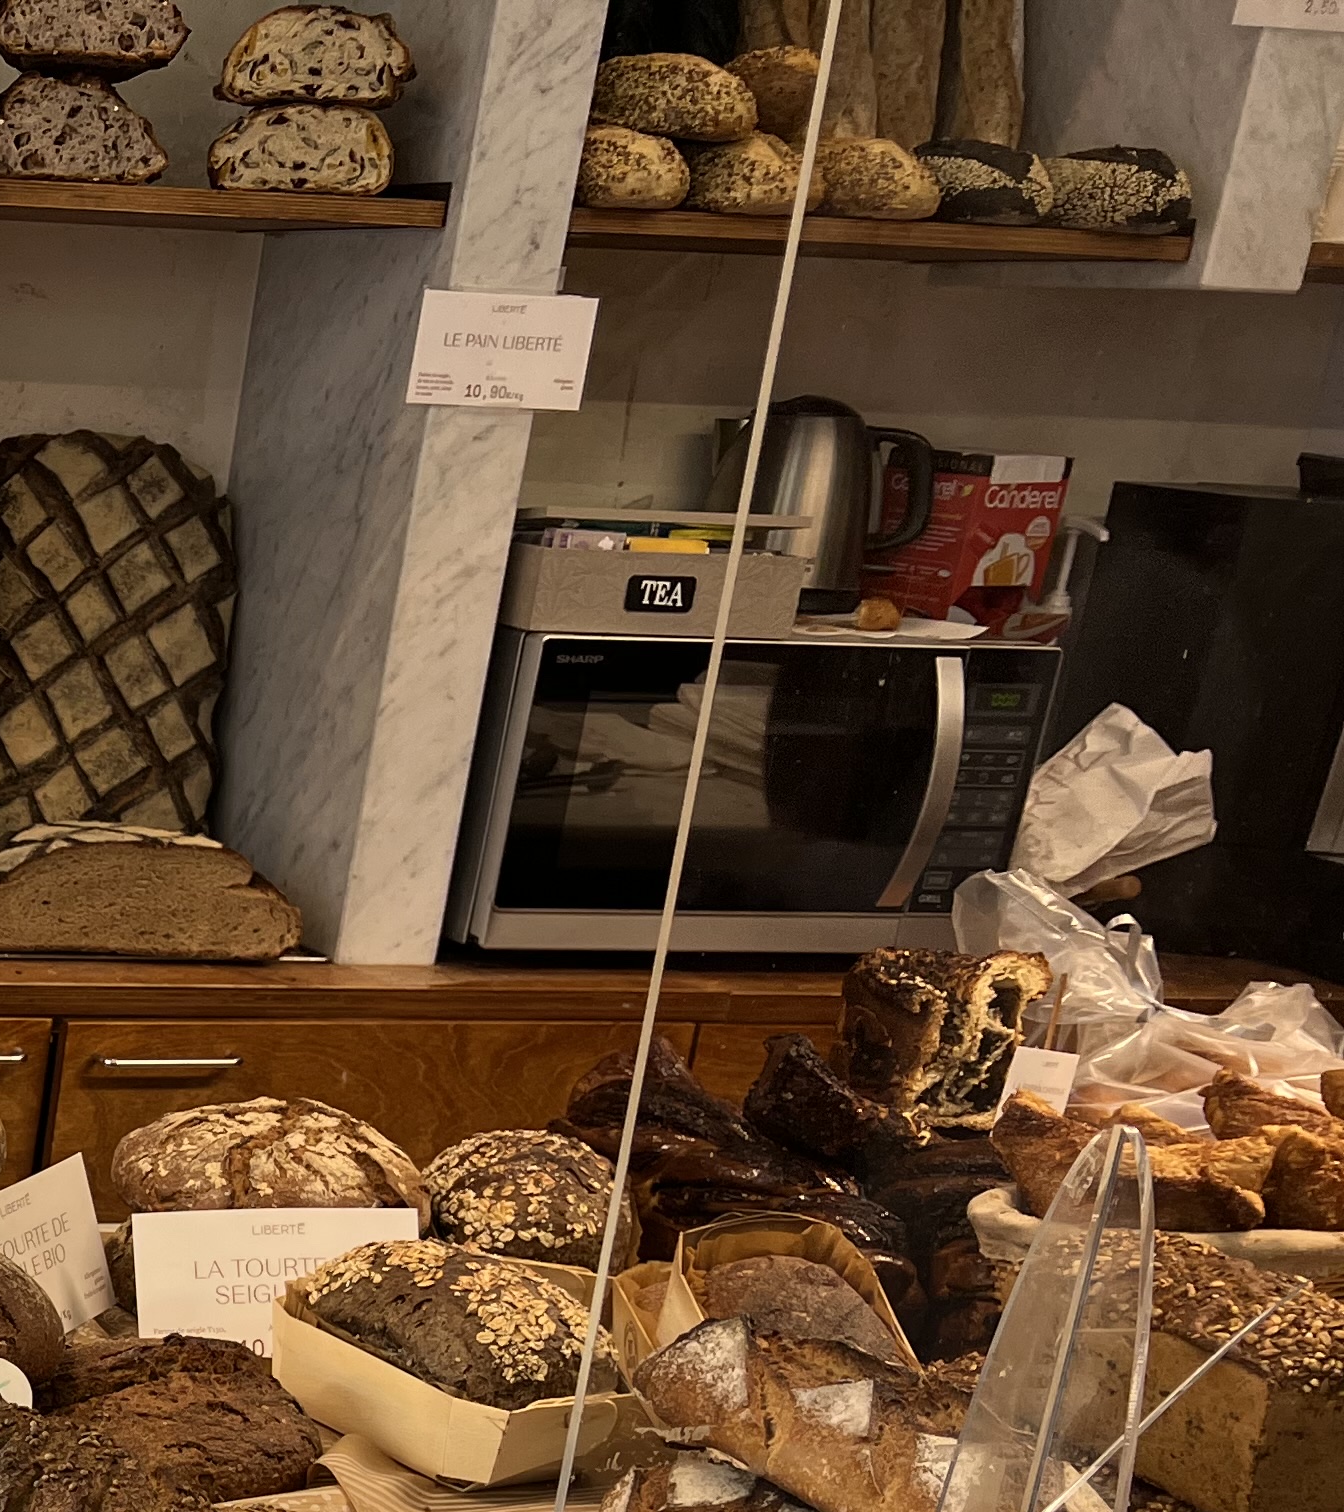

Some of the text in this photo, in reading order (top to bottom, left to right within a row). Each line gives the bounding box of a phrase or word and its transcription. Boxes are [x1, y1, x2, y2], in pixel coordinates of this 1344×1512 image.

[444, 332, 564, 352] LE PAIN LIBERTÉ
[984, 486, 1062, 509] Canderel
[640, 579, 683, 607] TEA
[556, 654, 604, 664] SHARP
[51, 1211, 71, 1238] DE
[252, 1222, 306, 1236] LIBERTÉ
[43, 1243, 66, 1271] BIO
[193, 1260, 225, 1279] LA
[215, 1284, 278, 1305] SEIG
